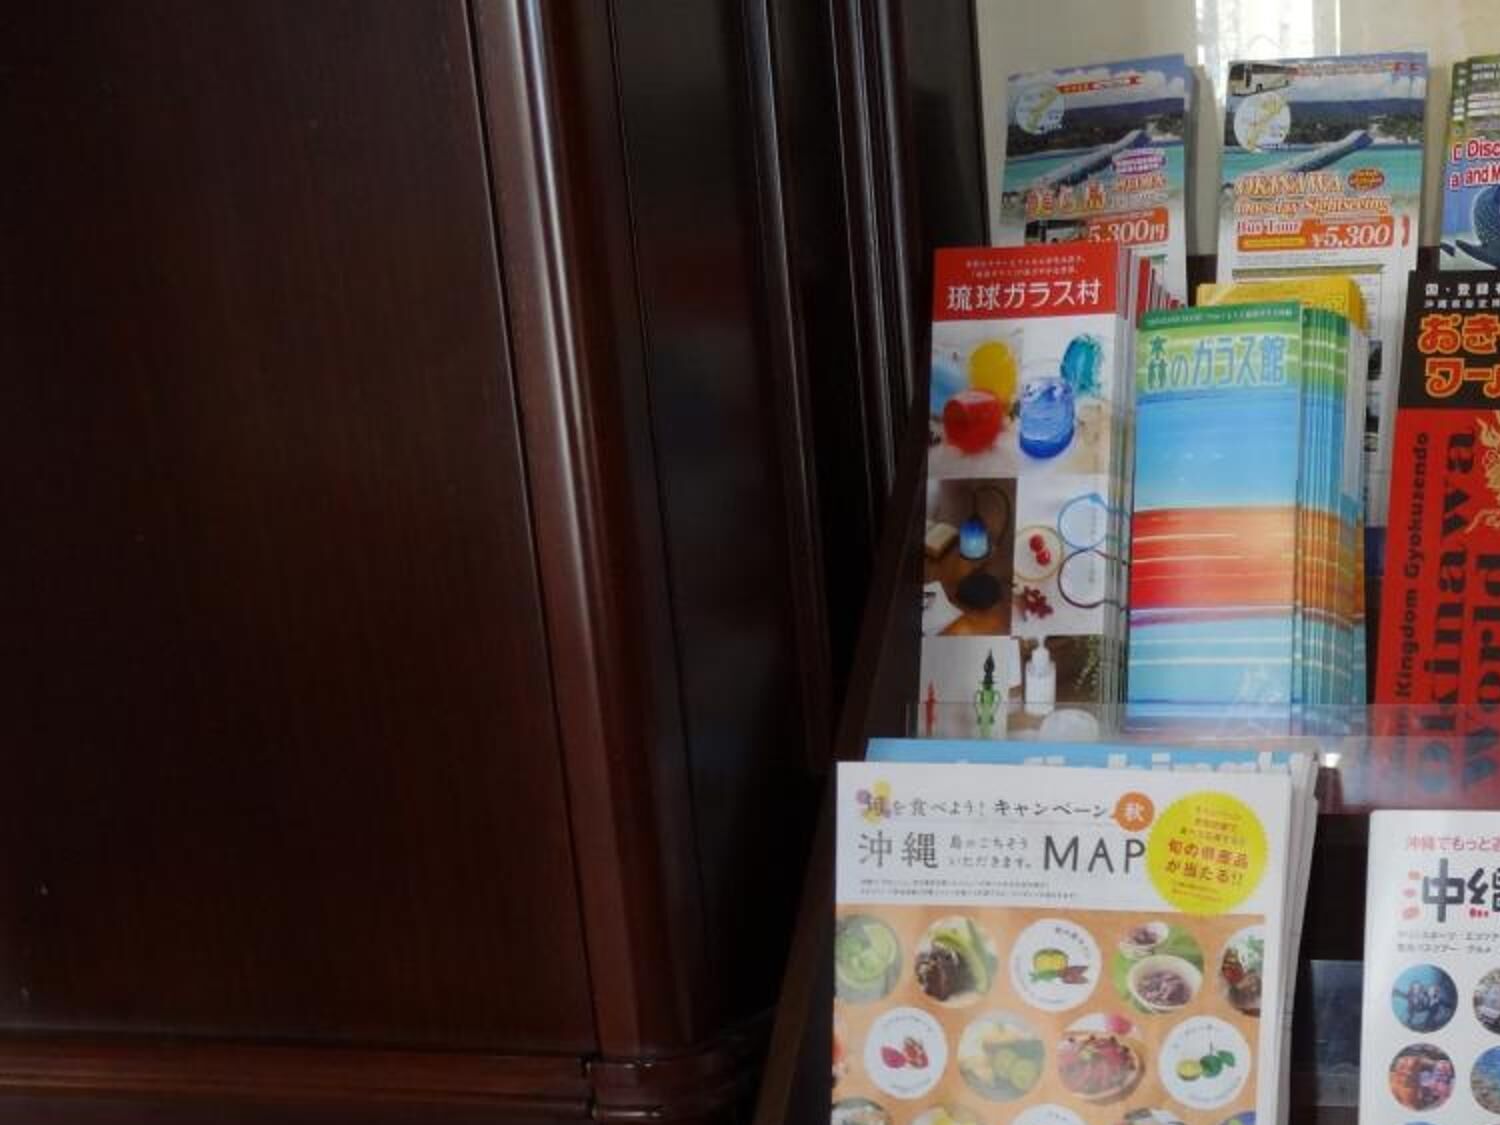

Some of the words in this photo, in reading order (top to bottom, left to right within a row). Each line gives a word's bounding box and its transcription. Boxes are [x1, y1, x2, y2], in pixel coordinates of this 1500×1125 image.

[1465, 166, 1490, 184] and
[948, 277, 1103, 311] 琉球ガラス村
[994, 799, 1107, 818] キャンペーン
[858, 830, 939, 869] 沖縄
[1043, 834, 1147, 875] MAP
